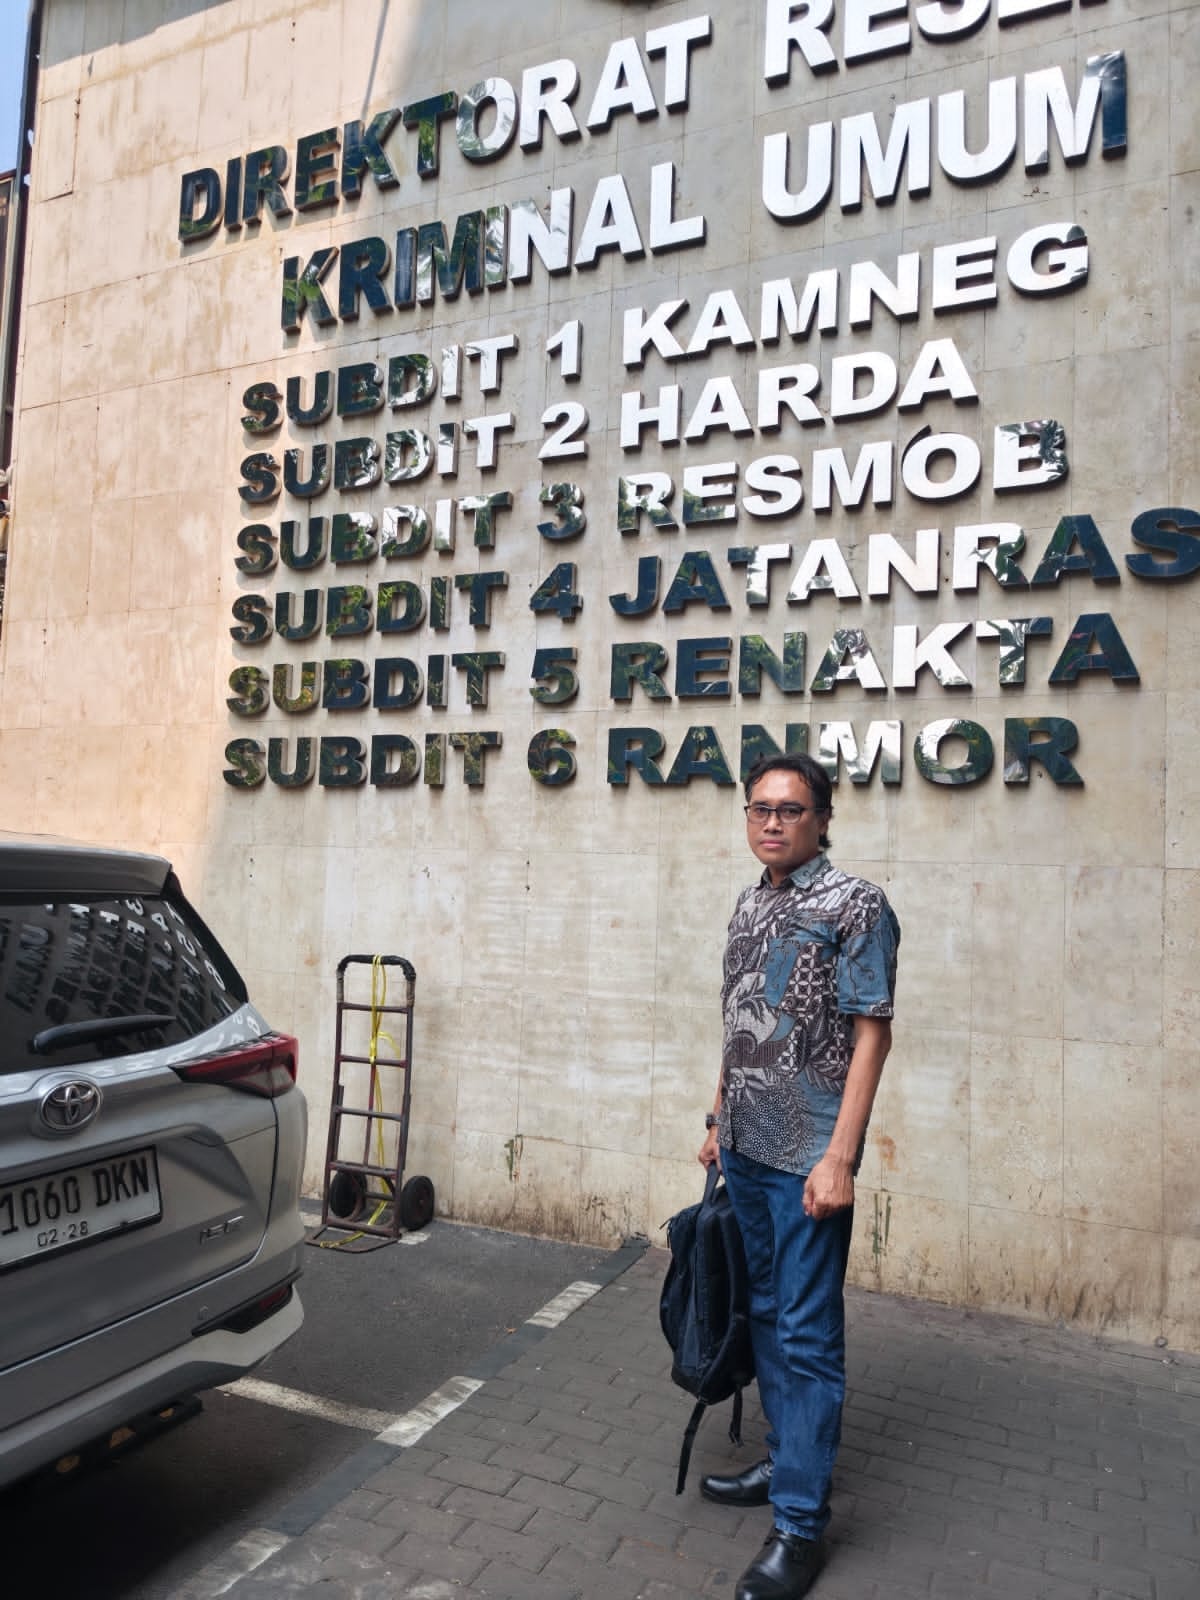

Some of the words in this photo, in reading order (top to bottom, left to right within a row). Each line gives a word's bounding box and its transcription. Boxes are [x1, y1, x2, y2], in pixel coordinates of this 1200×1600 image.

[178, 15, 712, 244] DIREKTORAT
[763, 0, 1074, 88] RE
[280, 162, 706, 334] KRIMINAL
[762, 50, 1127, 224] UMUM
[241, 334, 519, 433] SUBDIT
[546, 320, 582, 380] 1
[623, 222, 1089, 369] KAMNEG
[235, 491, 513, 574] SUBDIT
[537, 482, 586, 540] 3
[617, 419, 1068, 534] RESMOB
[238, 412, 514, 503] SUBDIT
[537, 402, 589, 461] 2
[620, 338, 979, 450] HARDA
[230, 570, 509, 644] SUBDIT
[530, 562, 583, 623] 4
[609, 507, 1200, 616] JATANRAS
[227, 651, 505, 716] SUBDIT
[529, 647, 579, 704] 5
[609, 613, 1140, 700] RENAKTA
[223, 731, 503, 788] SUBDIT
[527, 728, 577, 785] 6
[607, 717, 1086, 786] RANMOR
[0, 1176, 81, 1235] 1060
[92, 1157, 149, 1207] DKN
